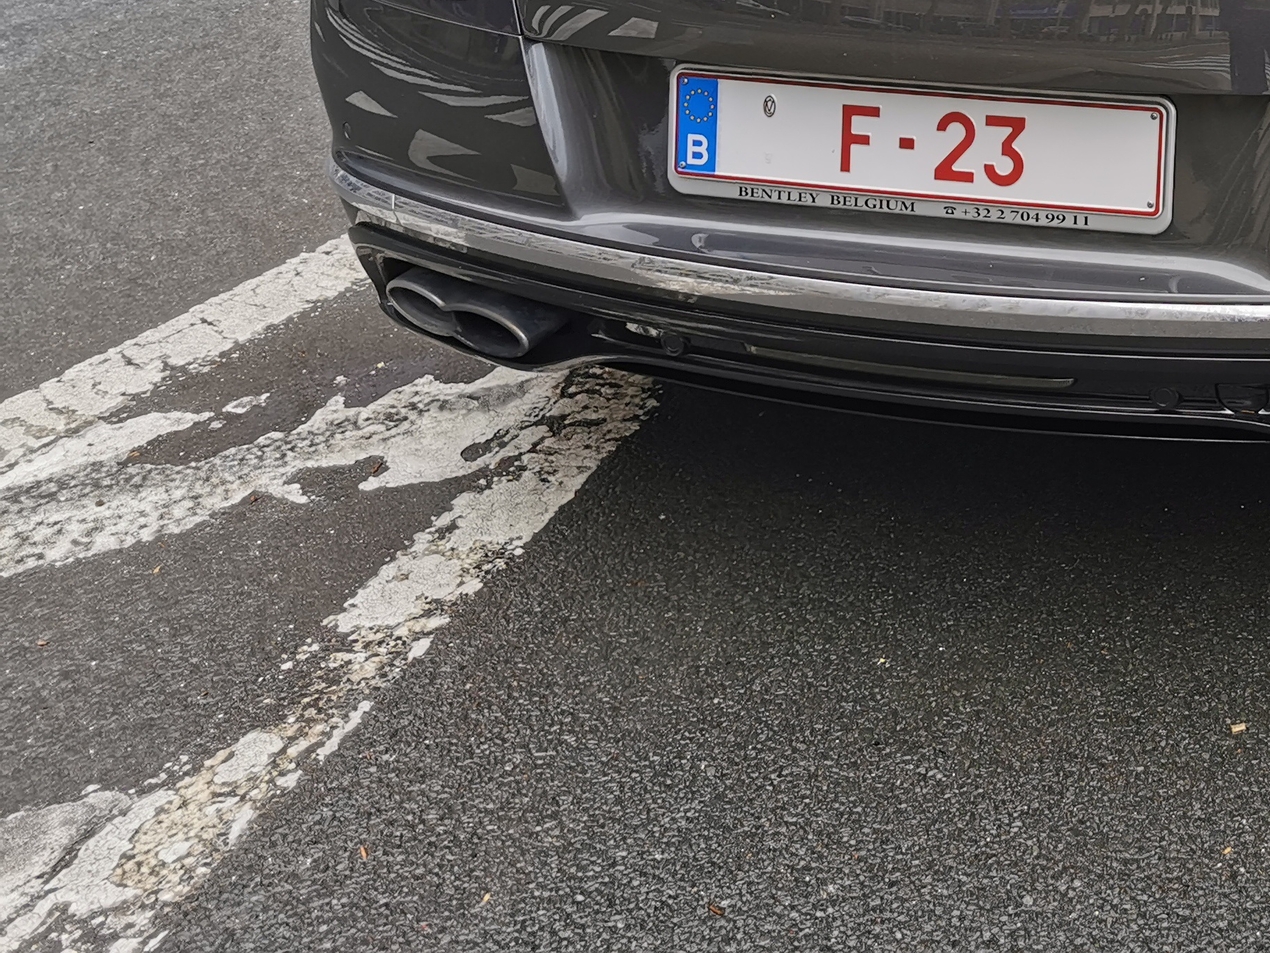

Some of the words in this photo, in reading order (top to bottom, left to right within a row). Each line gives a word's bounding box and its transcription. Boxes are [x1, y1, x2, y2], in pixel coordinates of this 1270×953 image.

[687, 133, 709, 165] B
[737, 186, 820, 204] BENTLEY
[829, 194, 917, 213] BELGIUM
[1010, 210, 1041, 223] 704
